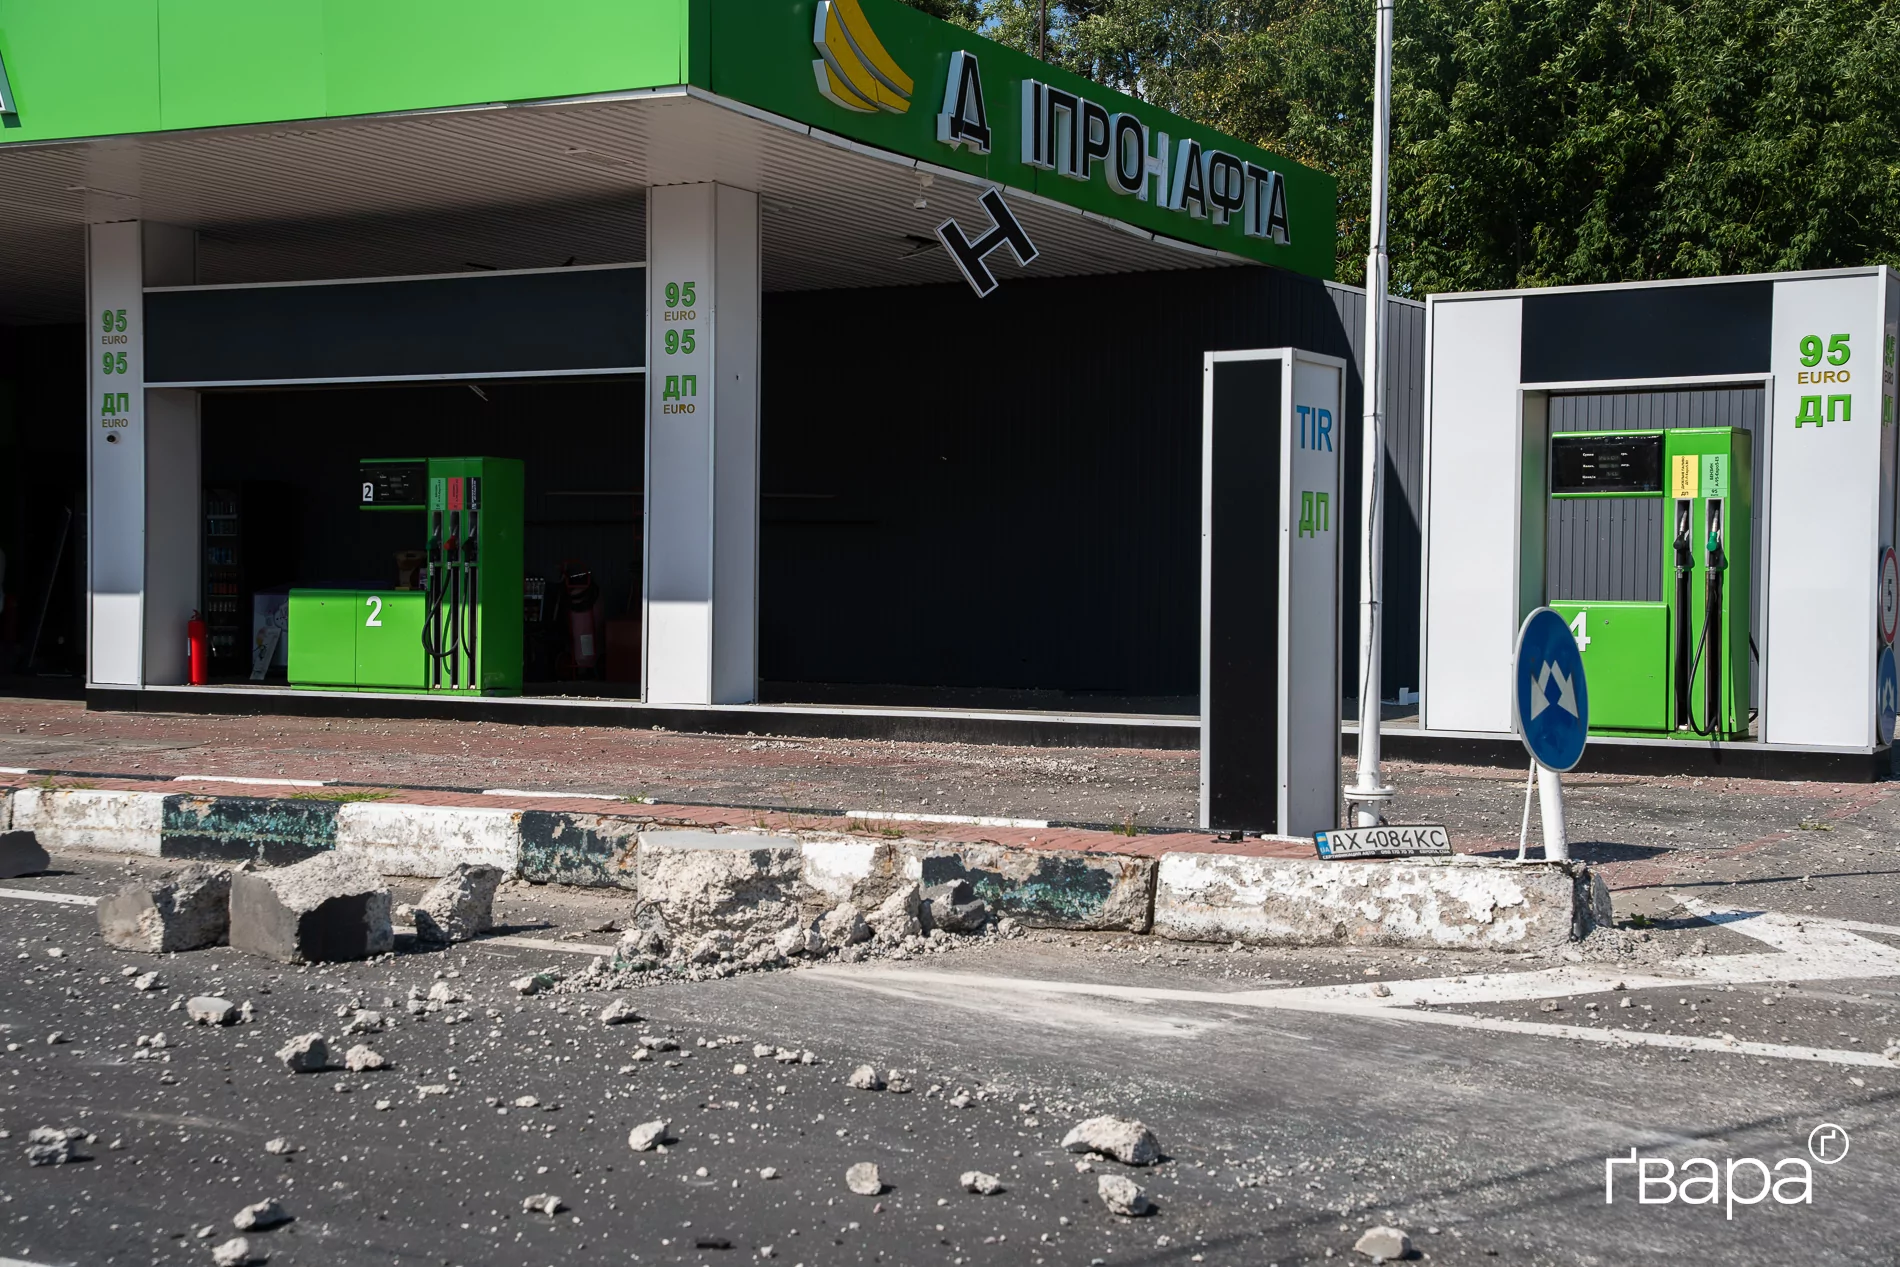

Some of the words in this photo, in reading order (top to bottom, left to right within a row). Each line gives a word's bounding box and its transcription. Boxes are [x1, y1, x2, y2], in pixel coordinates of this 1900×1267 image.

[665, 282, 696, 308] 95
[102, 310, 128, 333] 95
[664, 310, 696, 321] EURO
[102, 335, 128, 345] EURO
[665, 329, 696, 355] 95
[1799, 333, 1851, 367] 95
[102, 352, 128, 375] 95
[663, 375, 697, 401] ДП
[1797, 370, 1851, 385] EURO
[101, 393, 129, 416] ДП
[664, 404, 695, 414] EURO
[1795, 394, 1852, 428] ДП
[102, 419, 128, 428] EURO
[1296, 405, 1333, 452] TIR
[364, 485, 372, 499] 2
[1299, 491, 1329, 538] ДП
[1887, 579, 1892, 612] 5
[365, 596, 383, 627] 2
[1569, 612, 1591, 651] 4
